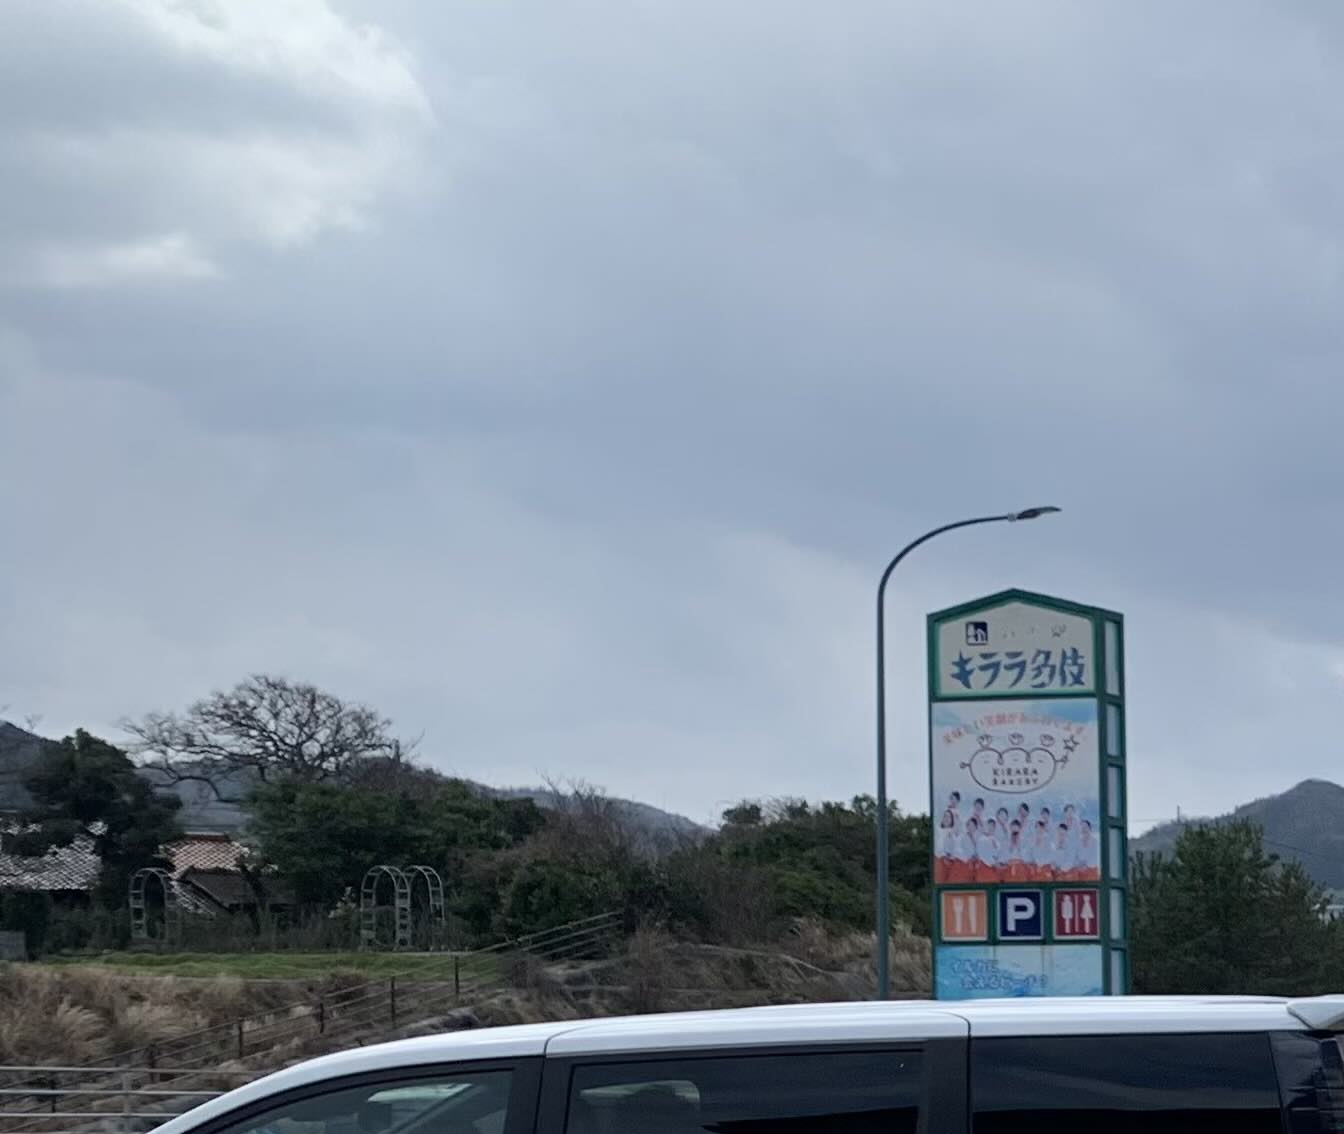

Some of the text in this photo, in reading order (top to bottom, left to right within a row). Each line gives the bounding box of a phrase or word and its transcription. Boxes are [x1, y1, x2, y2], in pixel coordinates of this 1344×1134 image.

[950, 647, 1085, 689] キララ多伎
[992, 767, 1039, 777] KIRARA
[1006, 897, 1035, 932] P
